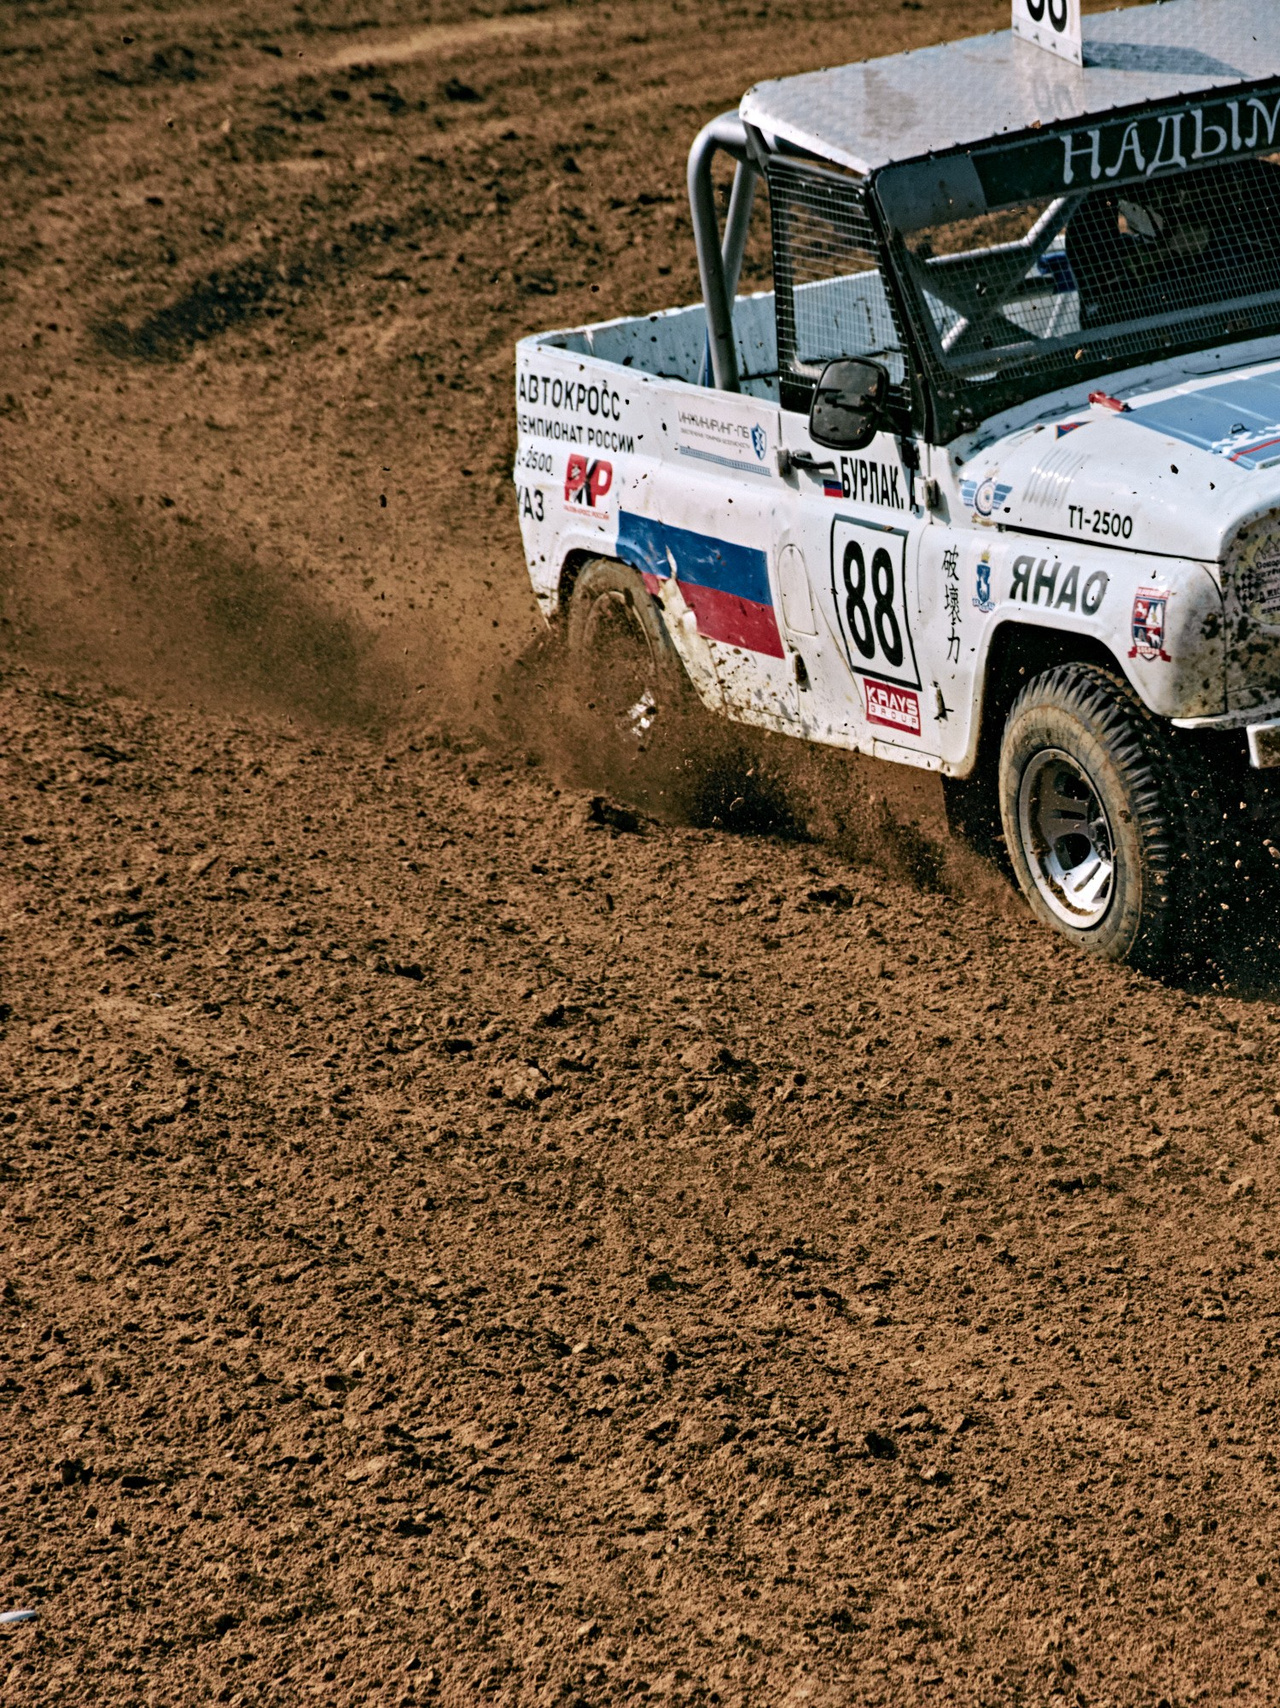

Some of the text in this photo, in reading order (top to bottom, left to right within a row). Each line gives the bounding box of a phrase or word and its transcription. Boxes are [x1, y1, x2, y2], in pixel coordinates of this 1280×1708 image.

[518, 373, 620, 421] АВТОКРОСС
[587, 427, 635, 454] РОССИИ
[843, 540, 903, 667] 88
[941, 544, 962, 664] 破壞力
[1009, 555, 1109, 616] ЯНАО
[866, 685, 918, 717] KRAYS
[870, 704, 917, 725] GROUP
